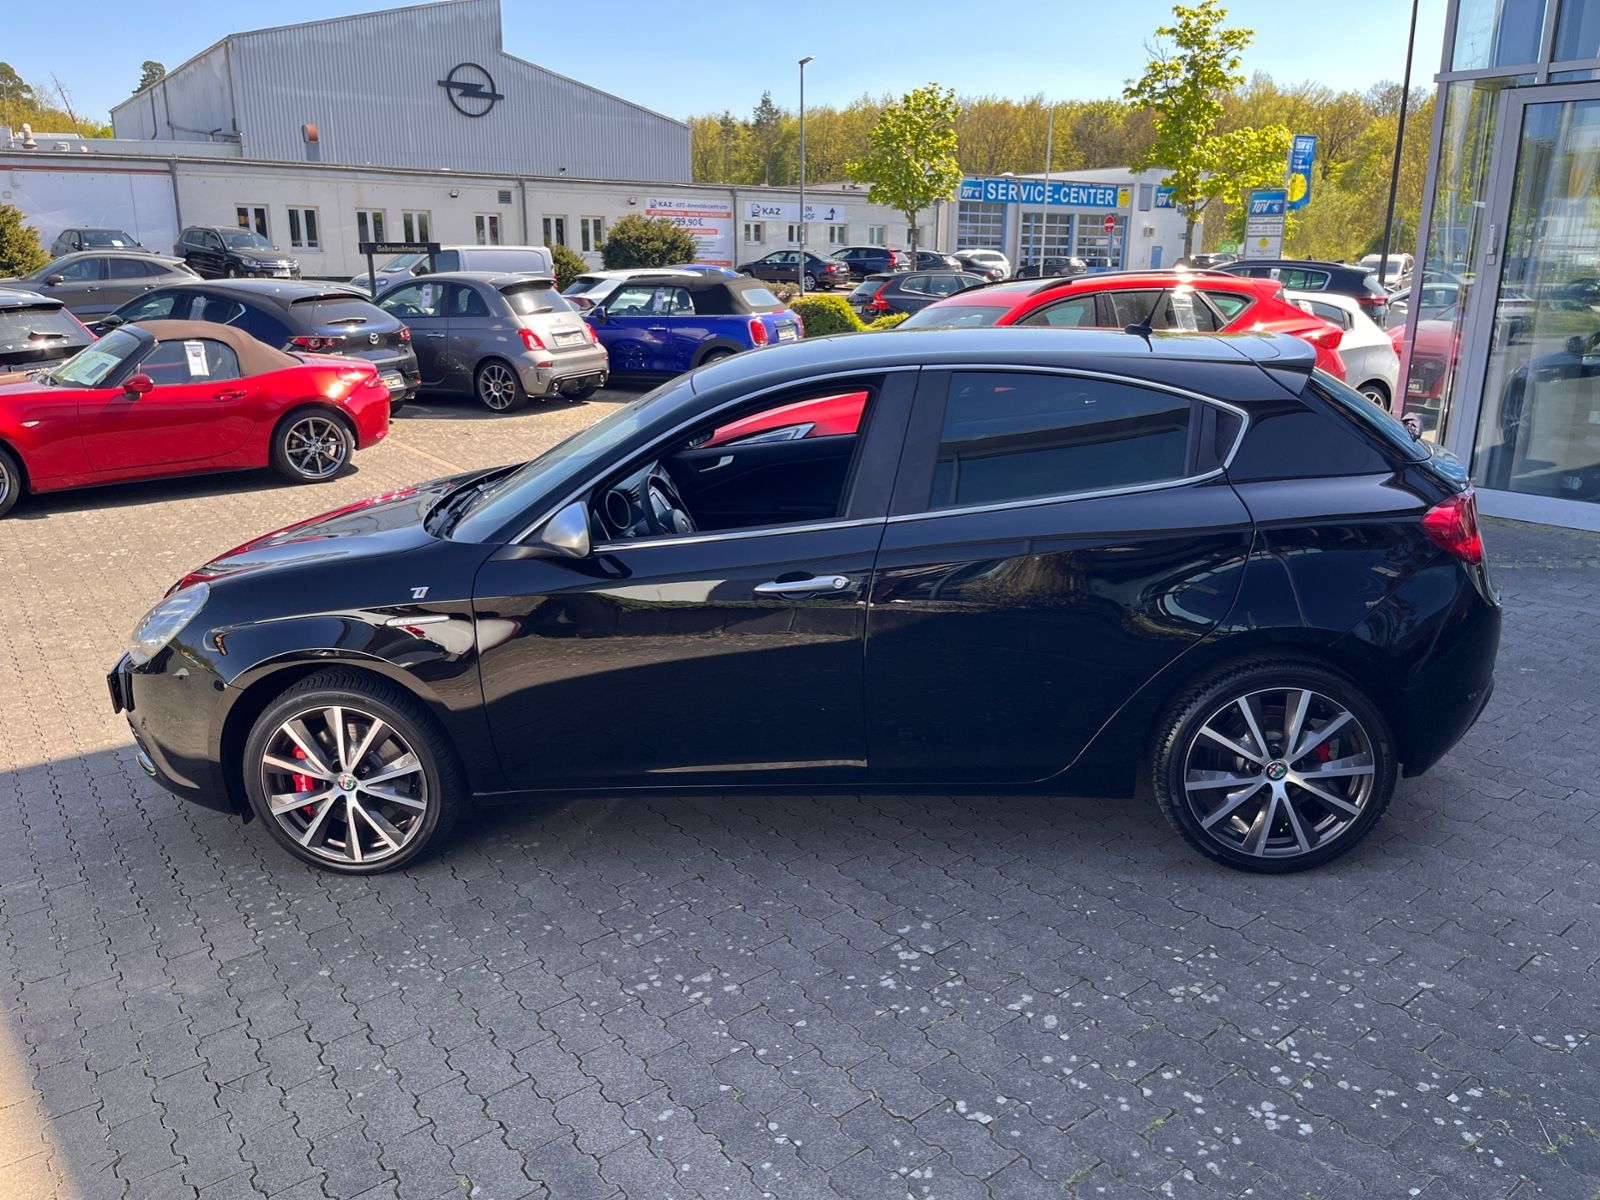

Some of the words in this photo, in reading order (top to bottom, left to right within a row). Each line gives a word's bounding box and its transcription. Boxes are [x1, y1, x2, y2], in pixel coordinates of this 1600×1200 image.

[986, 182, 1114, 205] SERVICE-CENTER
[762, 207, 781, 215] KAZ
[376, 244, 428, 253] Gebrauchtwagen
